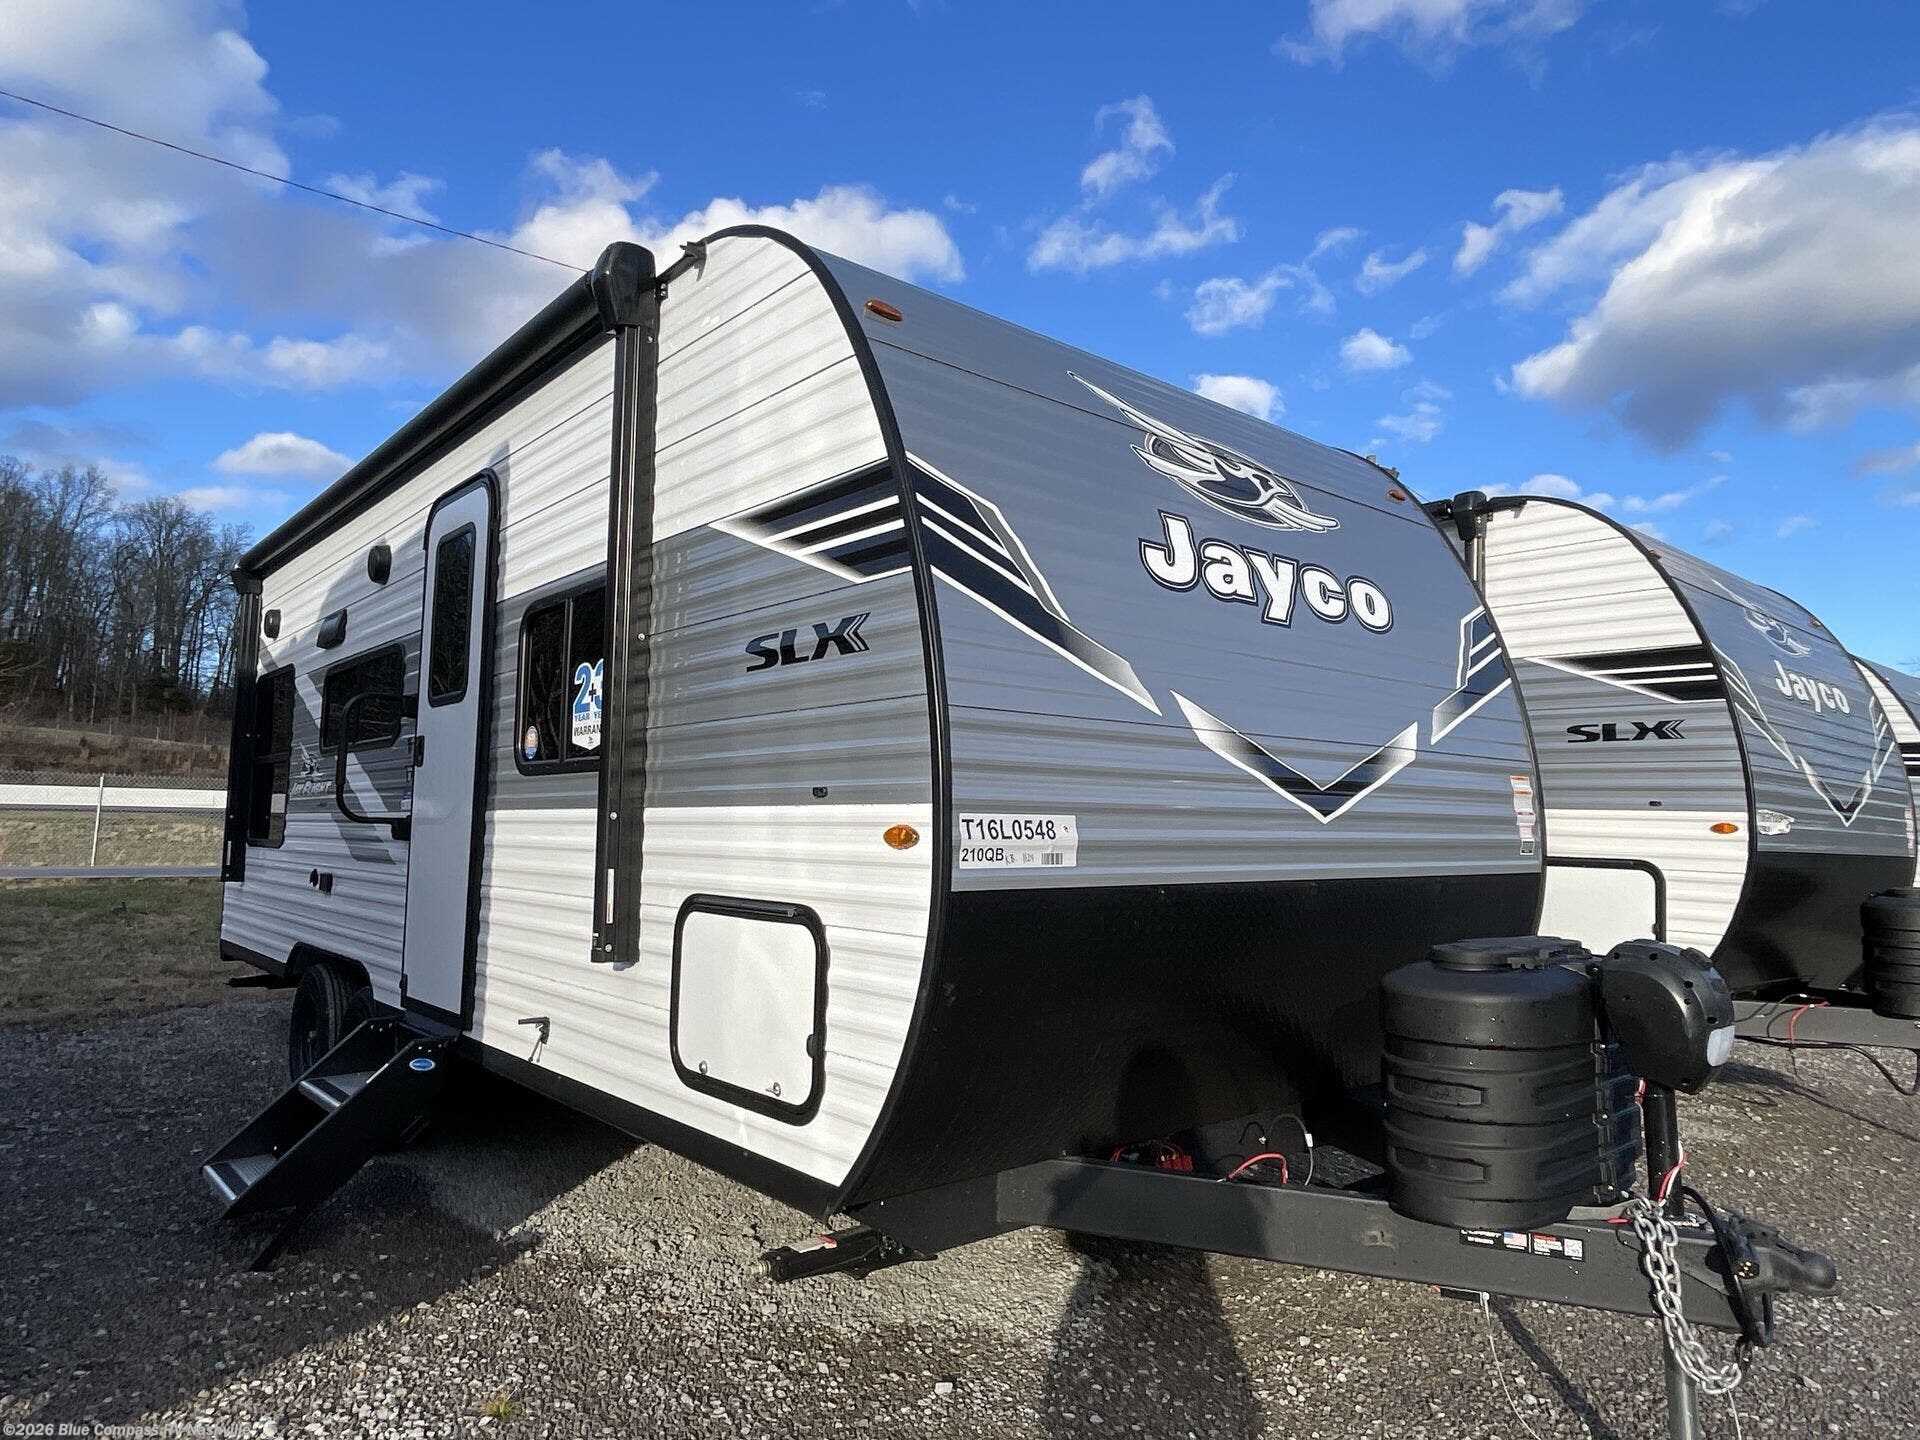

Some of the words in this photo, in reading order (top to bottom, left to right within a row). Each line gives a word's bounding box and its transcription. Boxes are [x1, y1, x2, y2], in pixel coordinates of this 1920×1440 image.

[1139, 510, 1394, 633] Jayco
[745, 612, 871, 672] SLX
[1773, 659, 1850, 714] Jayco
[575, 712, 591, 722] YEAR
[574, 724, 601, 736] WARRAN
[1566, 719, 1686, 743] SLX
[961, 818, 1057, 840] T16L0548
[961, 847, 1005, 862] 210QB
